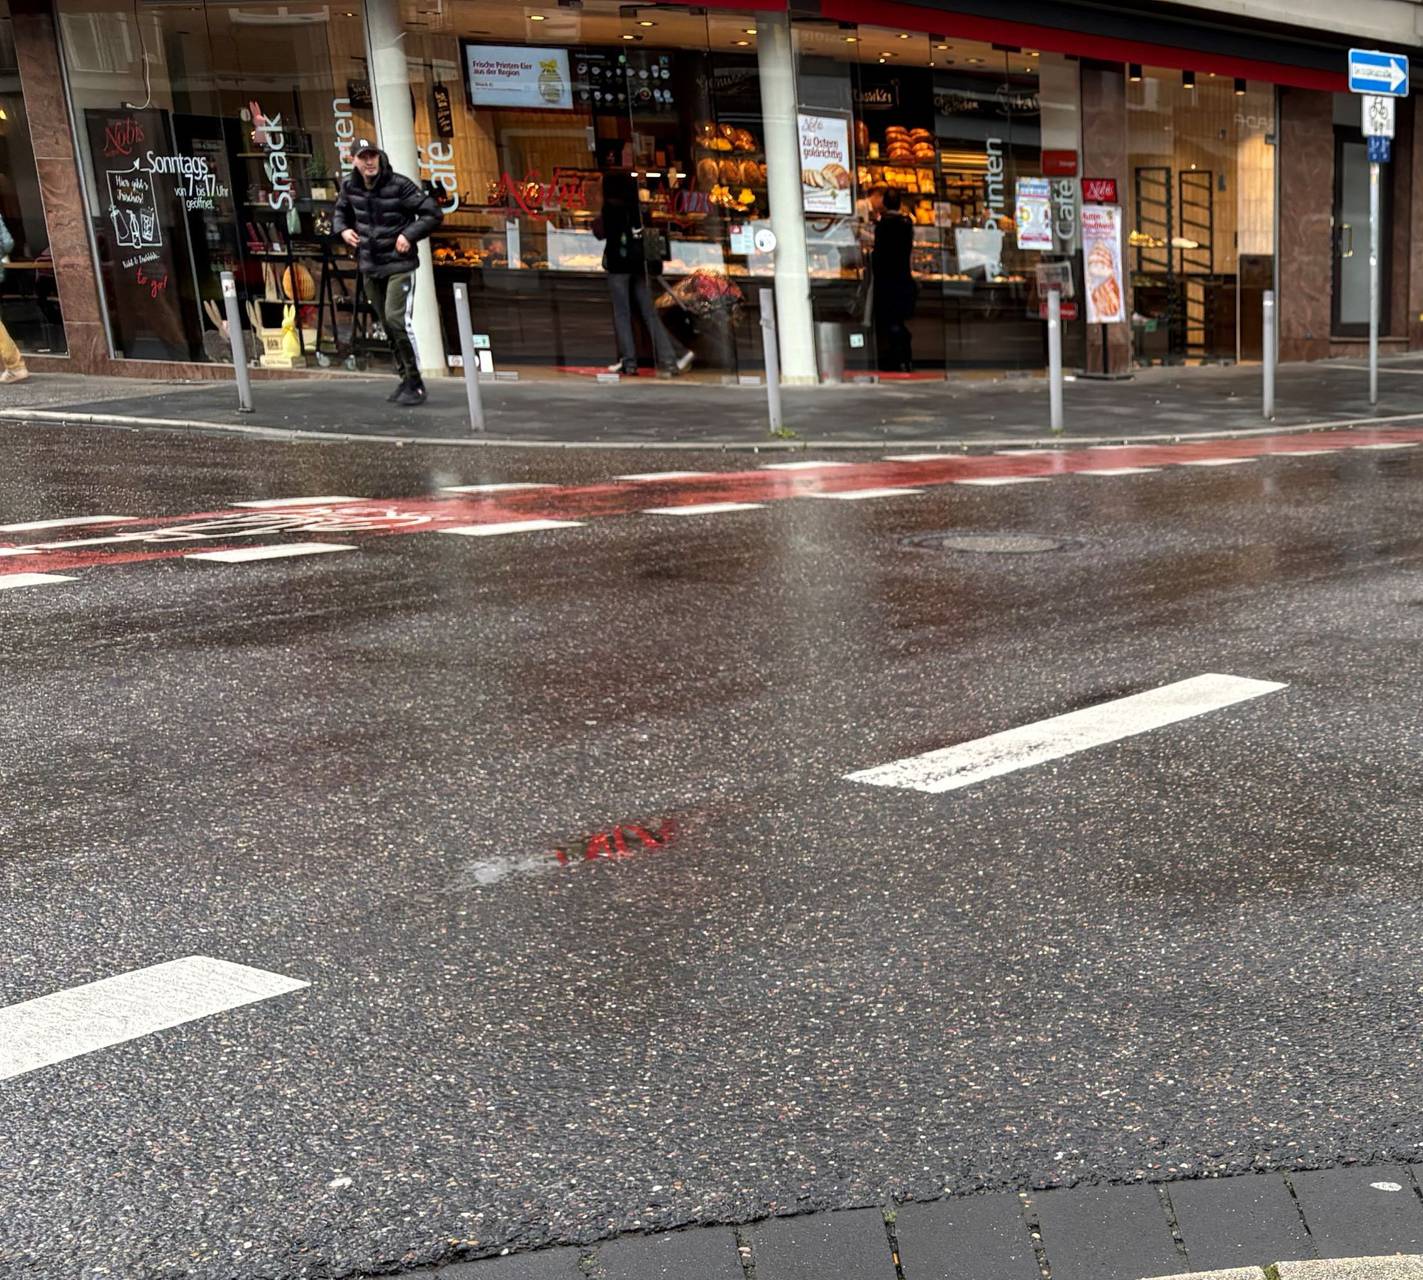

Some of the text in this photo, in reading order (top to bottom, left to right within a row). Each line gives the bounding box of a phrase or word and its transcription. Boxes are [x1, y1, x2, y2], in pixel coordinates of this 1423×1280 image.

[802, 135, 839, 149] Zu Ostern
[147, 151, 208, 180] Sonntags
[174, 174, 229, 197] von 7 bis 17 Uhr
[1053, 180, 1075, 240] Café
